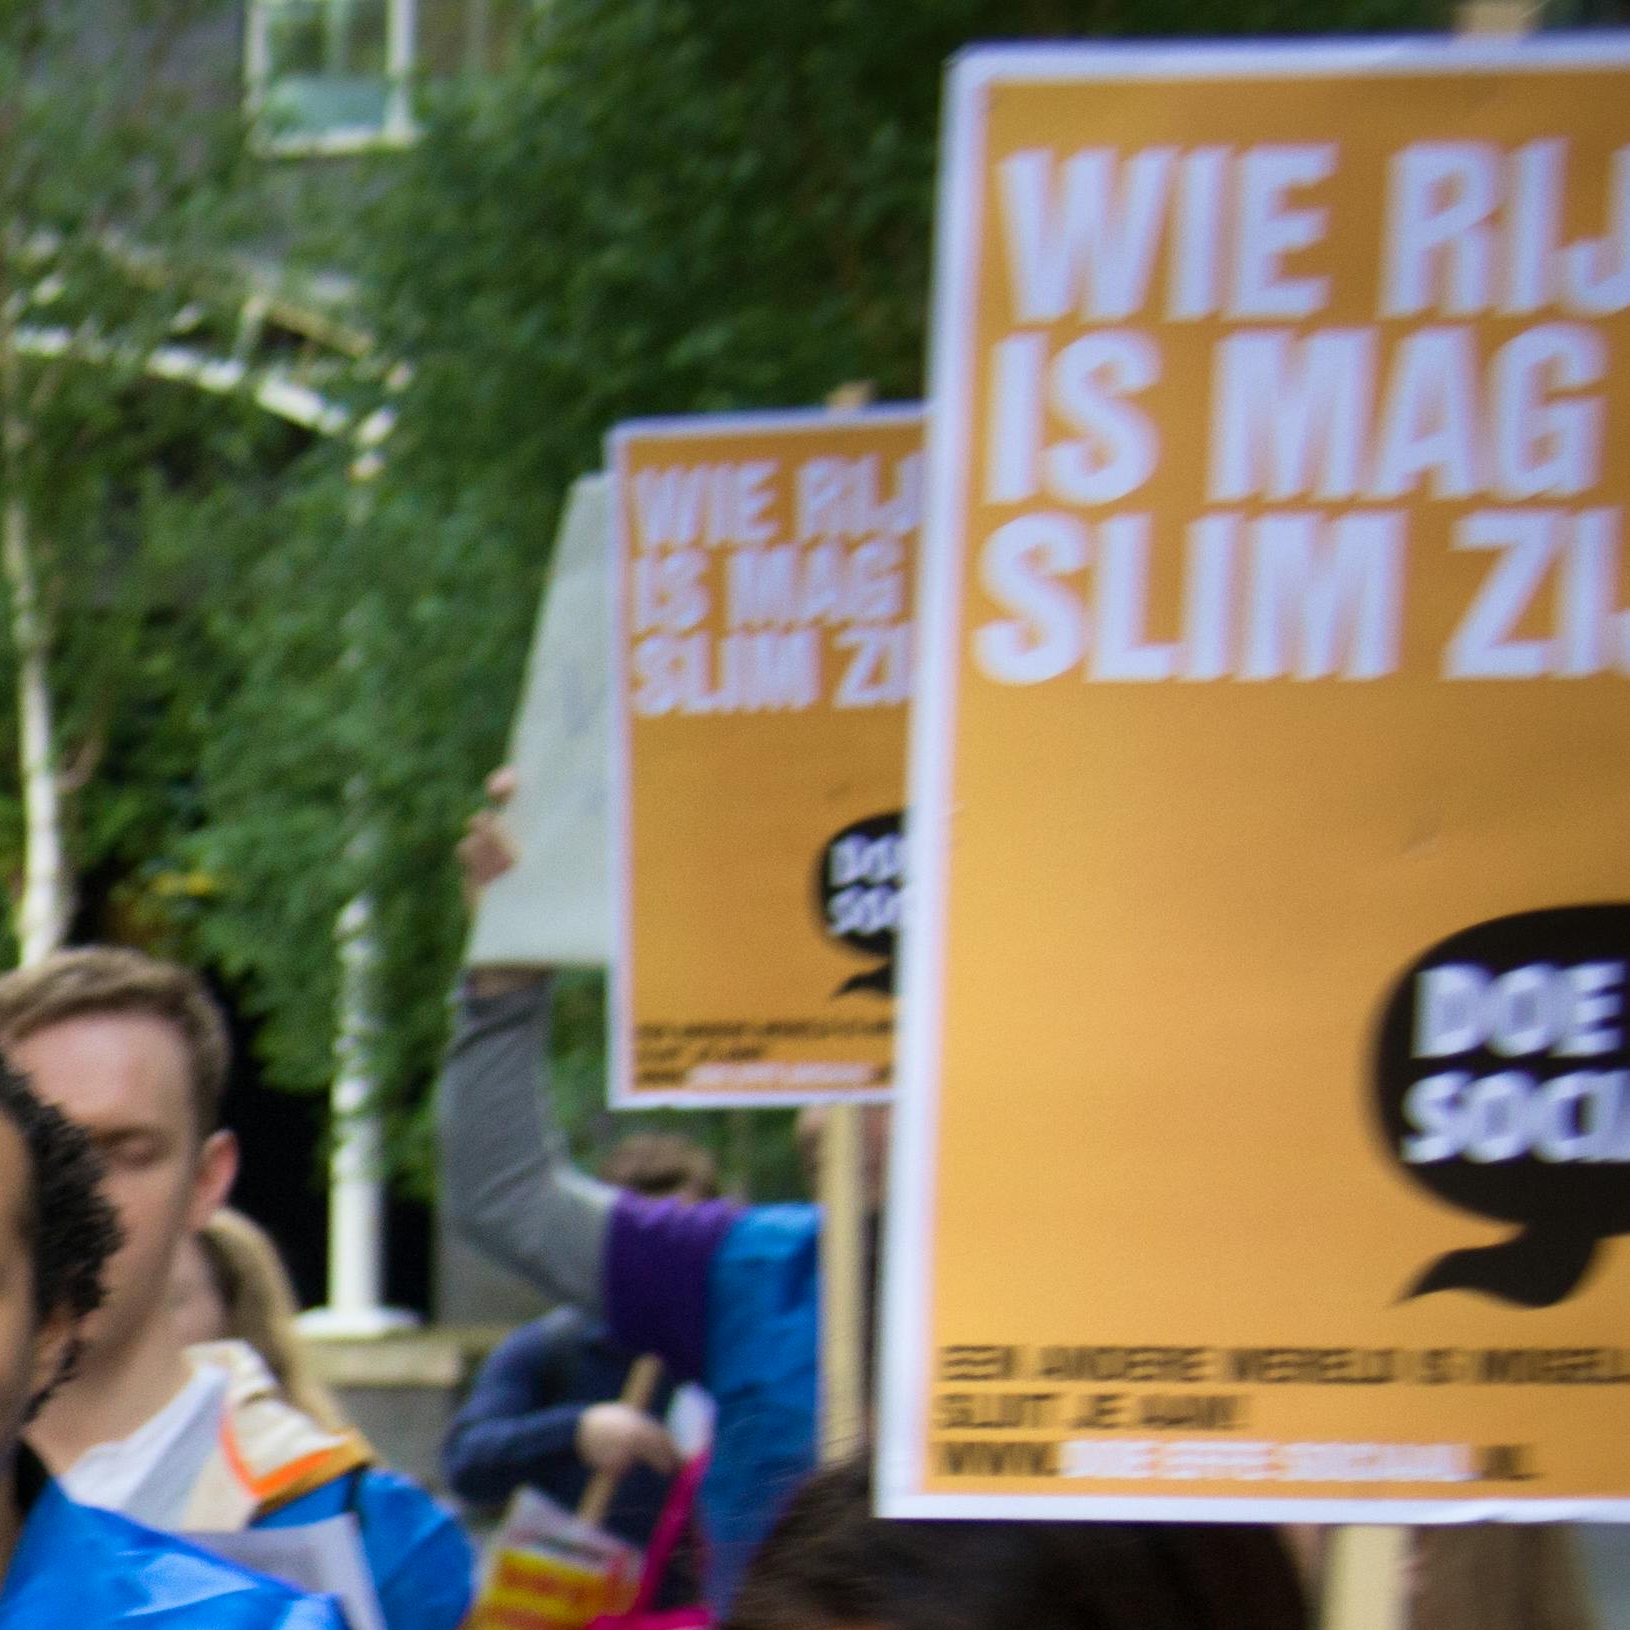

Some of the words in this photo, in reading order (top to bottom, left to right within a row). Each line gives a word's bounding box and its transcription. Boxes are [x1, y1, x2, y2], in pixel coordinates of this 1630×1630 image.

[995, 142, 1341, 324] WIE
[1379, 135, 1630, 320] RIJ
[984, 326, 1166, 505] IS
[1205, 321, 1613, 503] MAG
[973, 507, 1410, 687] SLIM
[1411, 959, 1627, 1060] DOE
